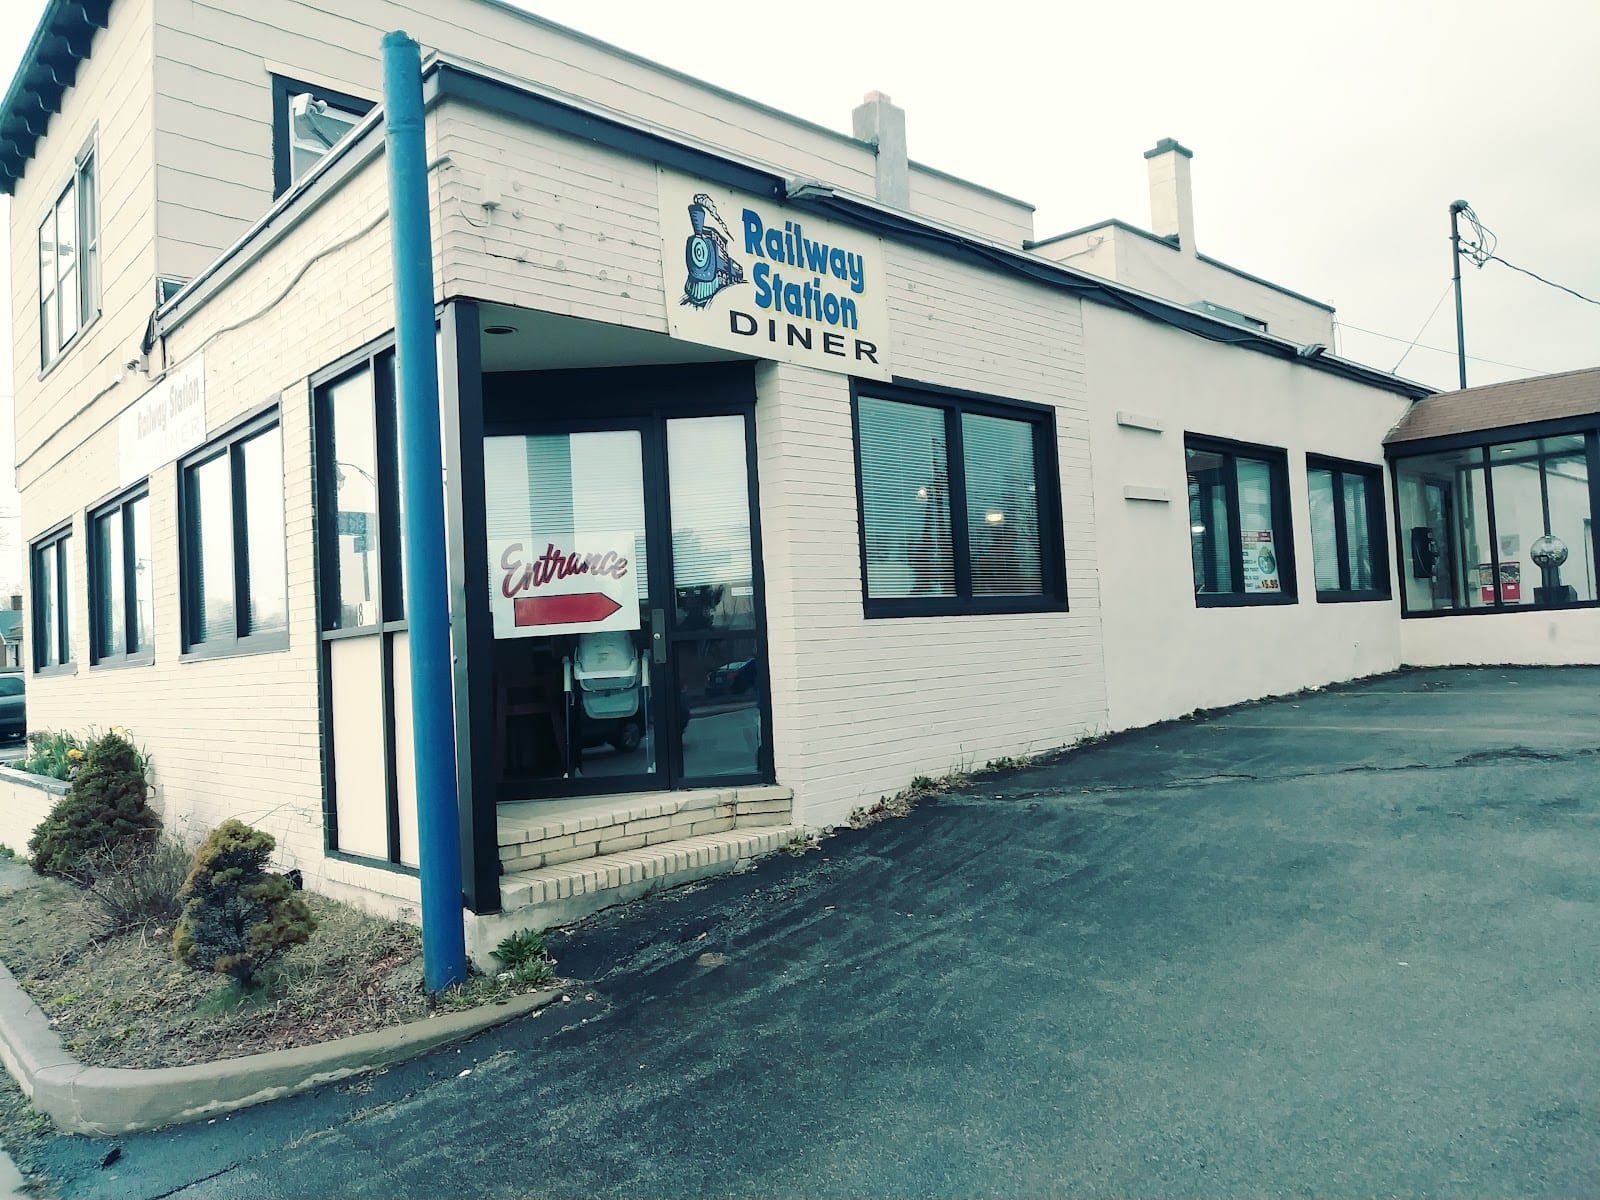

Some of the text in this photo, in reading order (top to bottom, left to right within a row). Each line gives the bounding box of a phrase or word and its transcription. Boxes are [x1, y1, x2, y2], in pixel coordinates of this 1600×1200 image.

[742, 208, 865, 294] Railway
[753, 262, 858, 330] Station
[729, 310, 879, 364] DINER
[137, 375, 199, 440] Railway Station
[501, 543, 628, 598] Entrance
